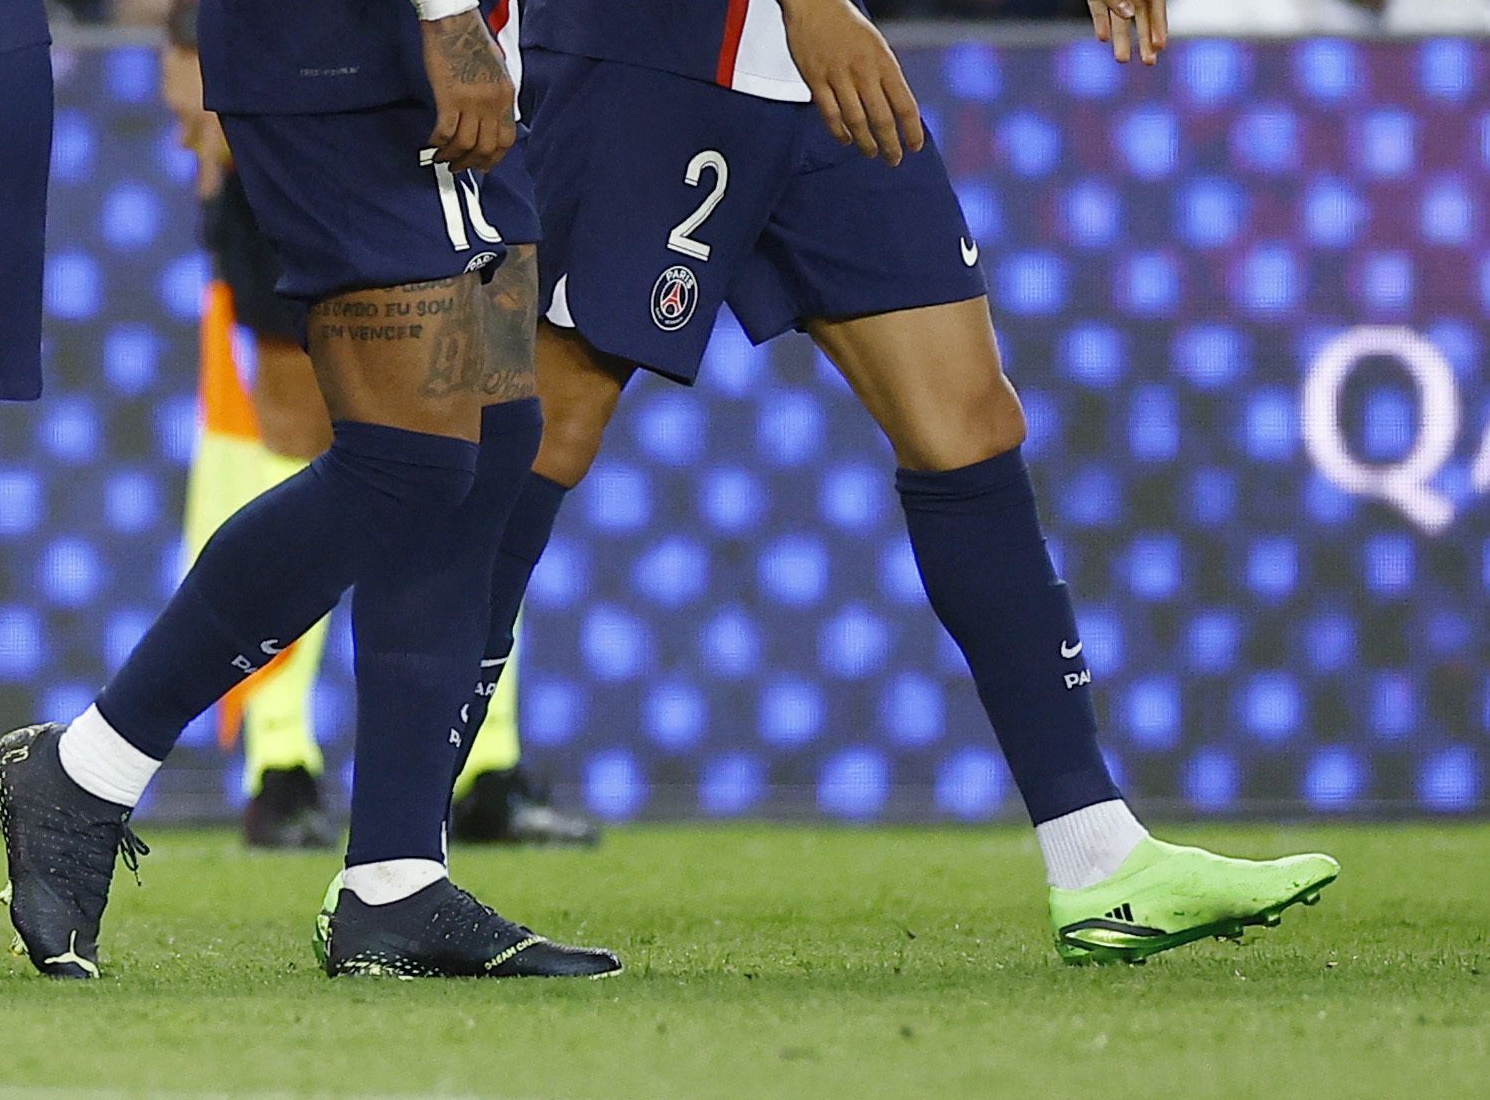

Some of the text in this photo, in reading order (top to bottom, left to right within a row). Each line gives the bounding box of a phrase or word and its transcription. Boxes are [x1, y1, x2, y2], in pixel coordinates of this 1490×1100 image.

[667, 150, 728, 261] 2
[666, 270, 694, 289] PARIS
[1300, 324, 1490, 537] Q
